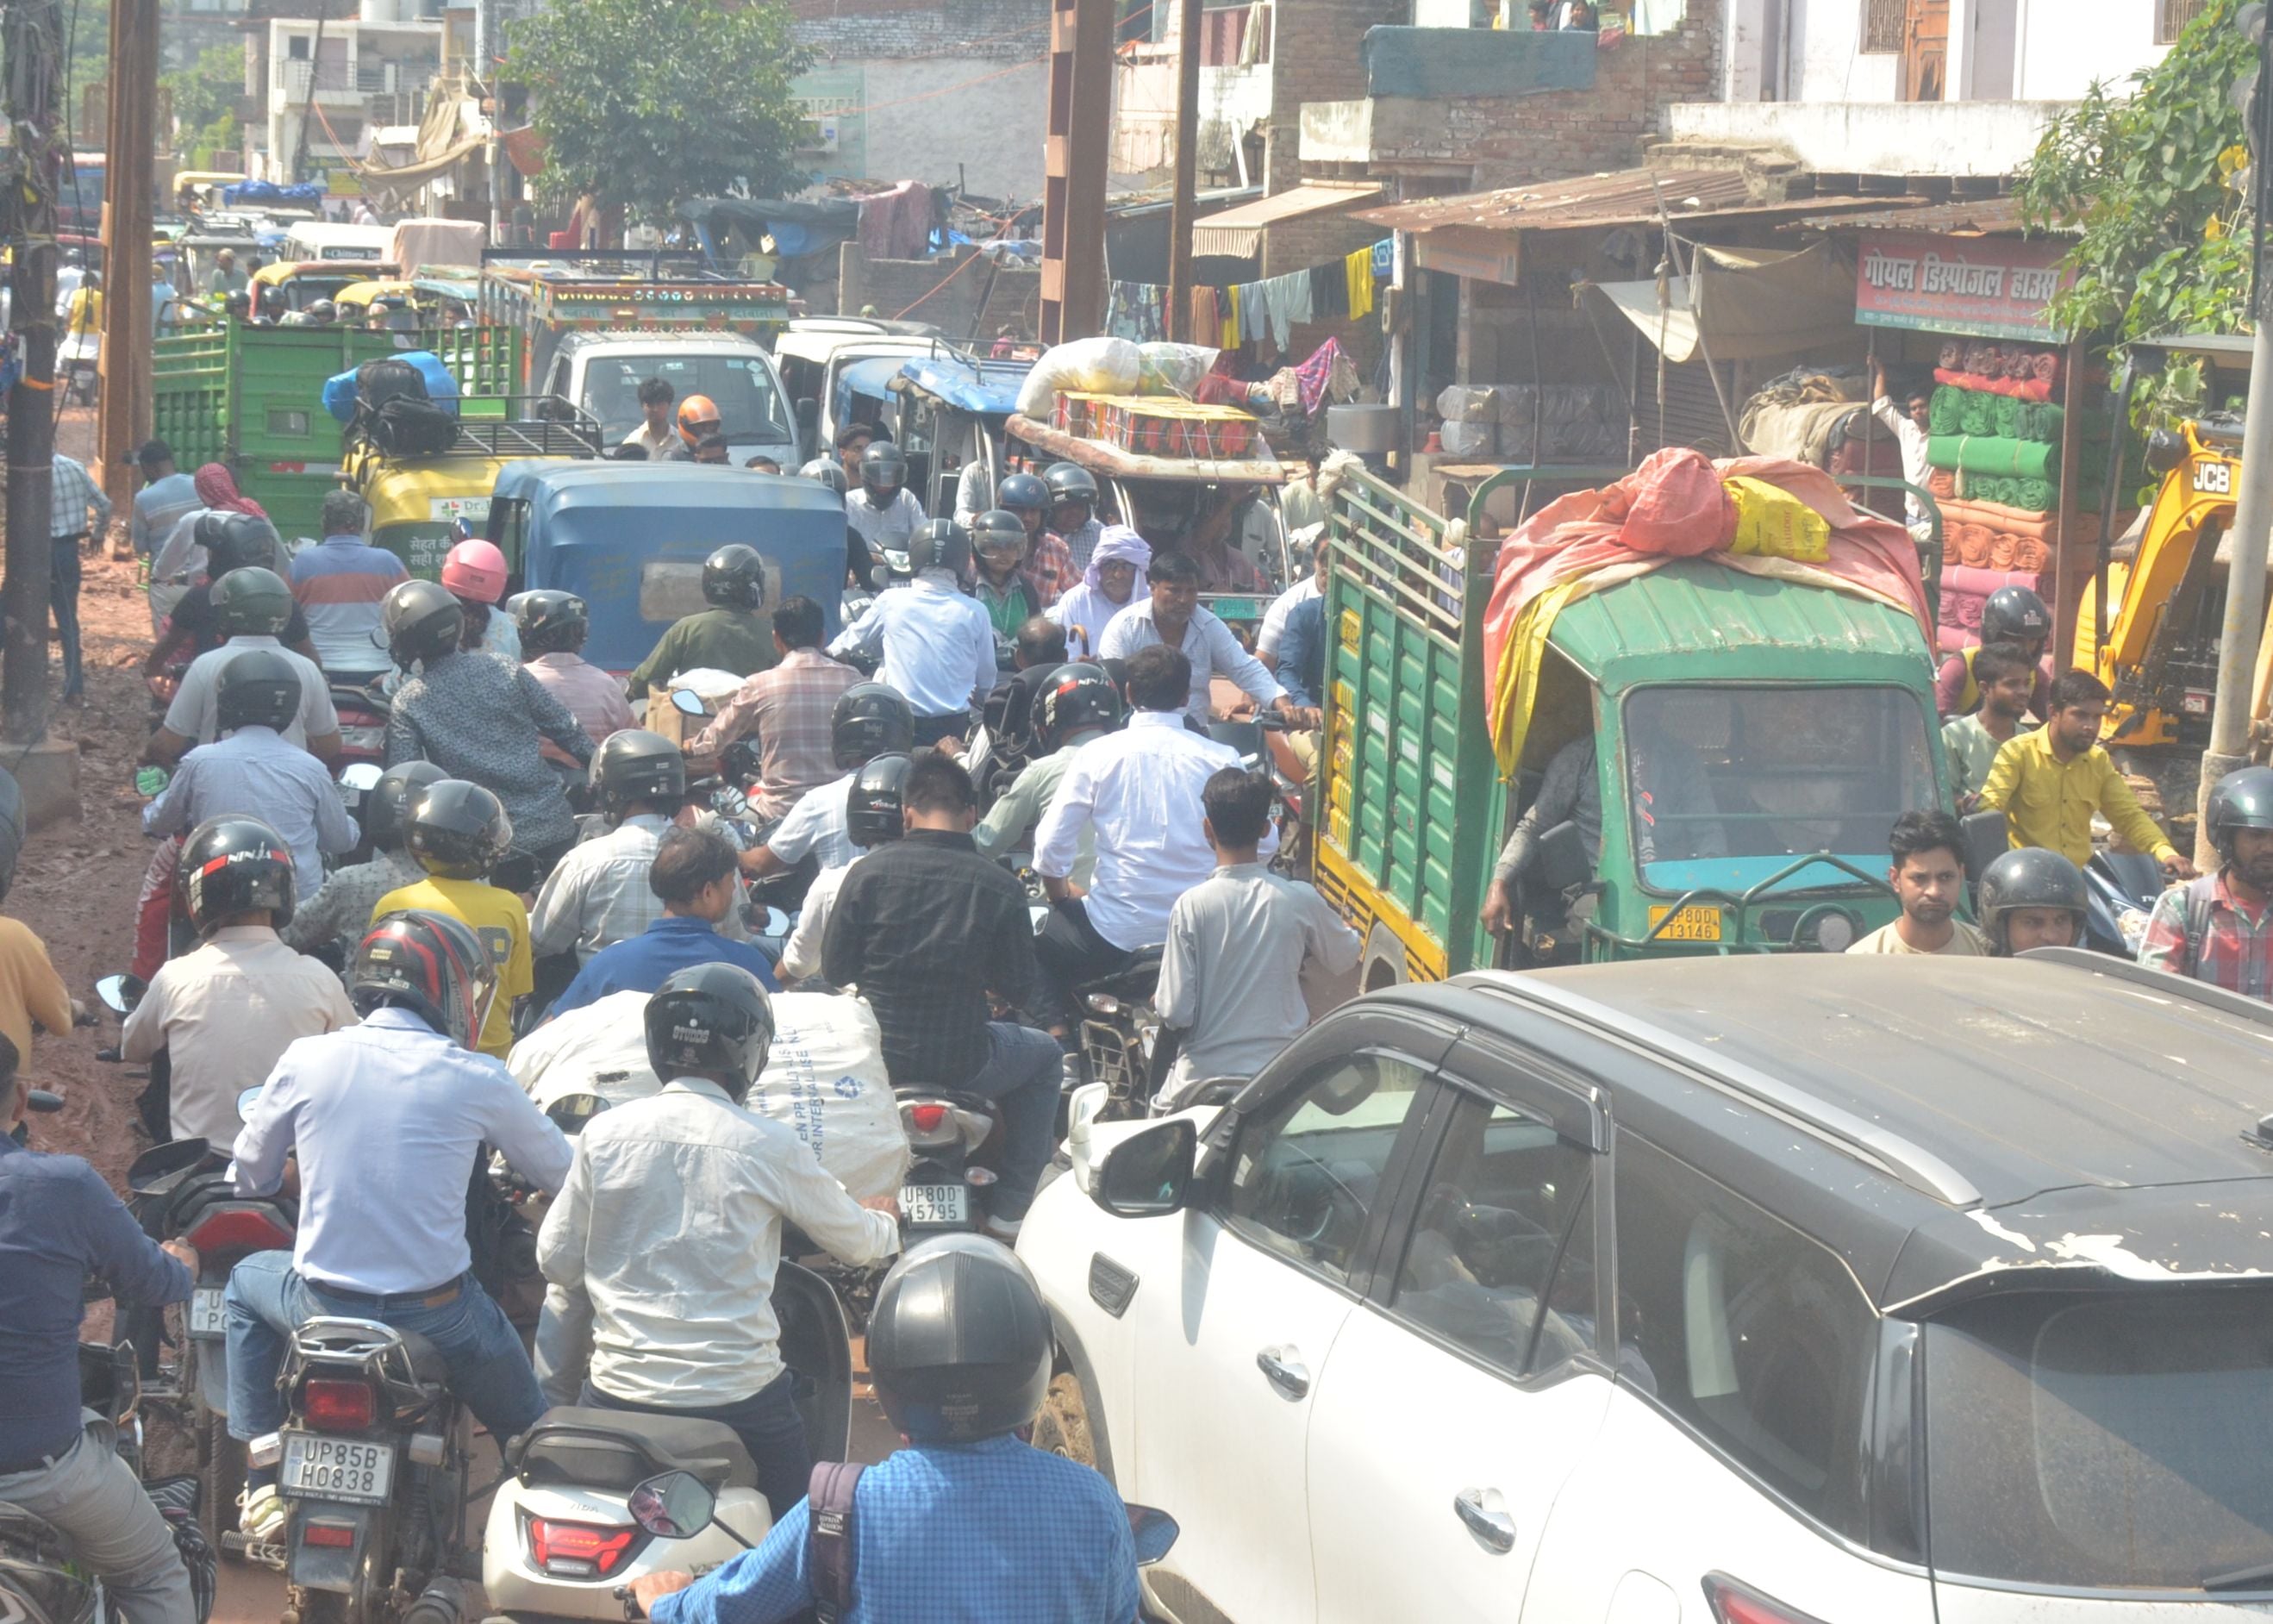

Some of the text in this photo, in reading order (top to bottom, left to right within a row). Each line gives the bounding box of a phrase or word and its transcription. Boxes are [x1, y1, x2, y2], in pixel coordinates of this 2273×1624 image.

[1864, 248, 2062, 301] गोयल डिस्पोजल हाउस
[2193, 463, 2230, 492] JCB
[227, 842, 272, 865] NINJA
[1675, 909, 1712, 923] P80D
[1669, 923, 1713, 939] T3146
[905, 1186, 956, 1202] UP80D
[305, 1440, 378, 1470] UP85B
[300, 1463, 375, 1492] H0838
